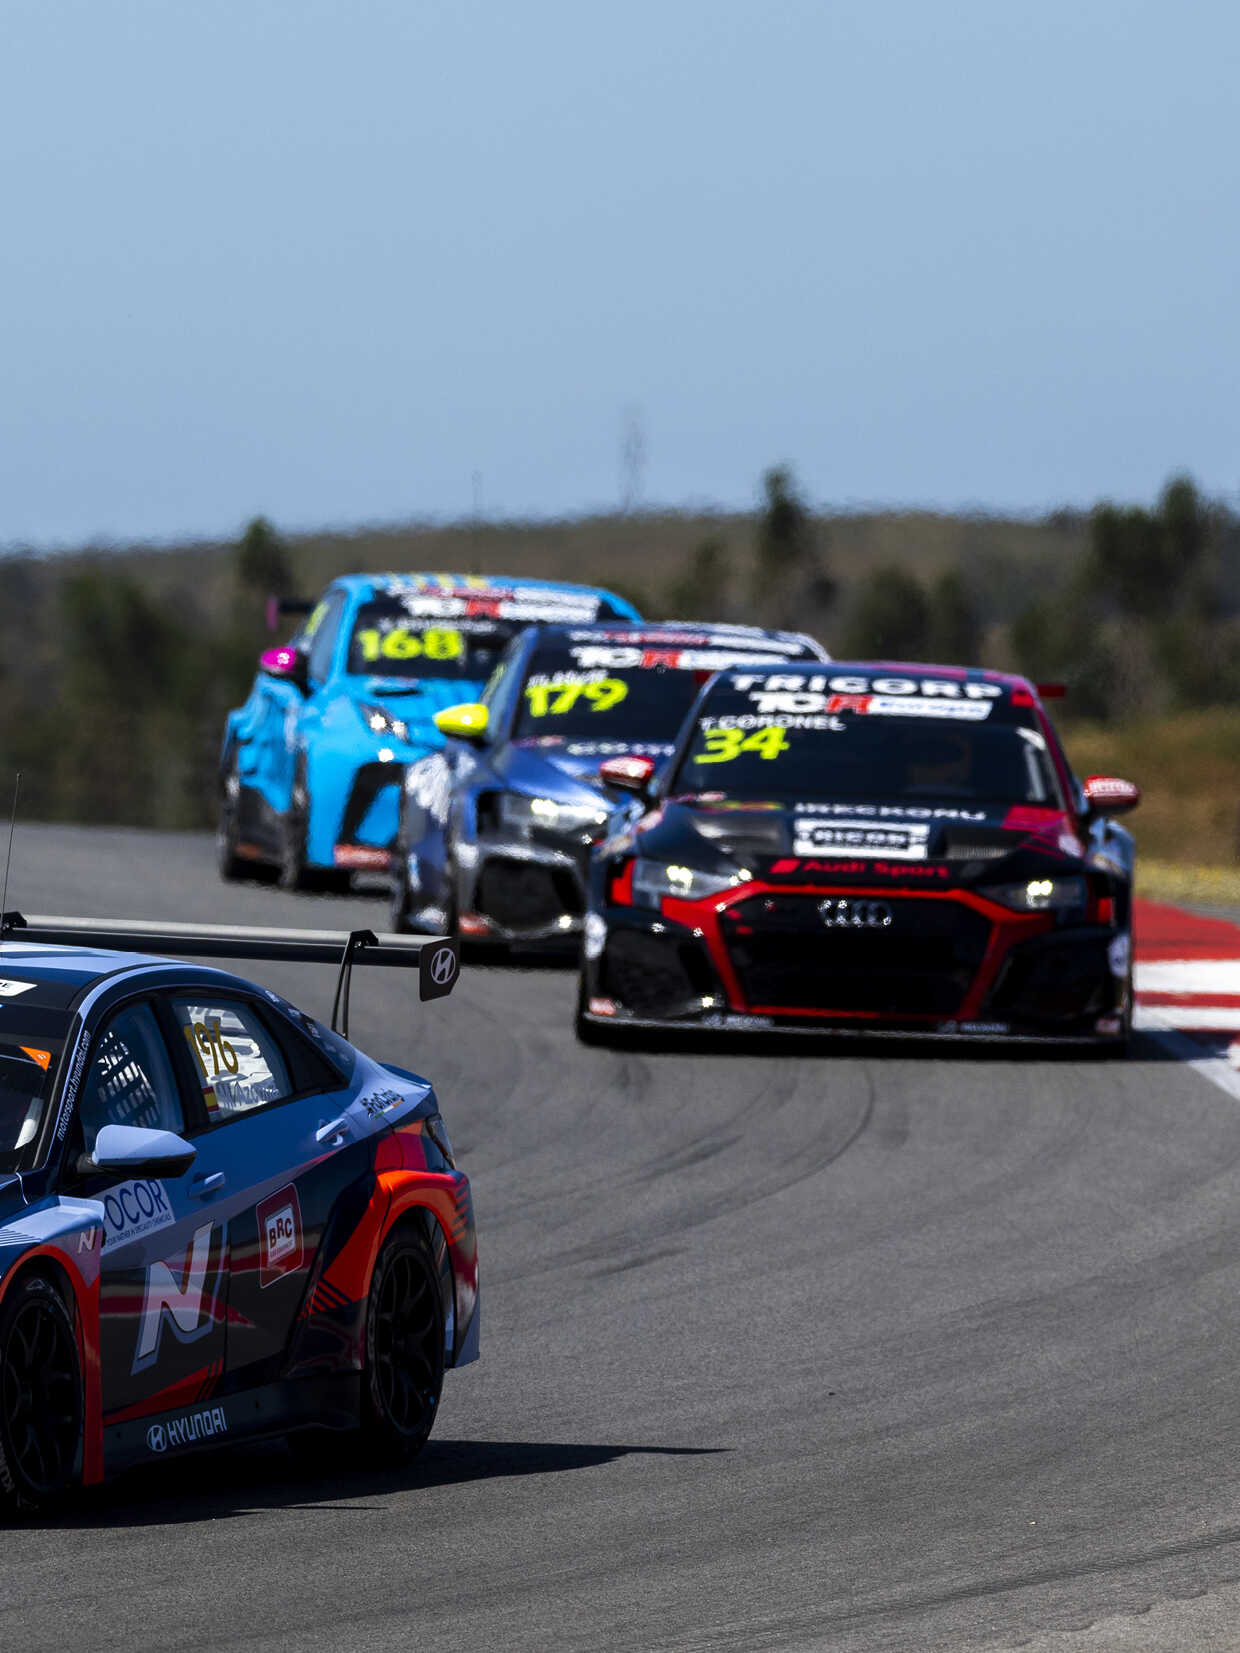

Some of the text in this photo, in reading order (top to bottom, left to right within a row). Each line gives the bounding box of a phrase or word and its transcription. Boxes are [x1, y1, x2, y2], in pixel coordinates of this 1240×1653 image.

[358, 627, 463, 661] 168
[525, 678, 628, 717] 179
[730, 673, 1003, 699] TRICORP
[693, 726, 790, 764] 34
[803, 860, 949, 879] Audi Sport
[184, 1020, 239, 1078] 196
[57, 1030, 92, 1142] motorsport.hyundai.com
[104, 1179, 168, 1232] OCOR
[268, 1217, 293, 1249] BRC
[167, 1406, 228, 1446] HYUNDAI
